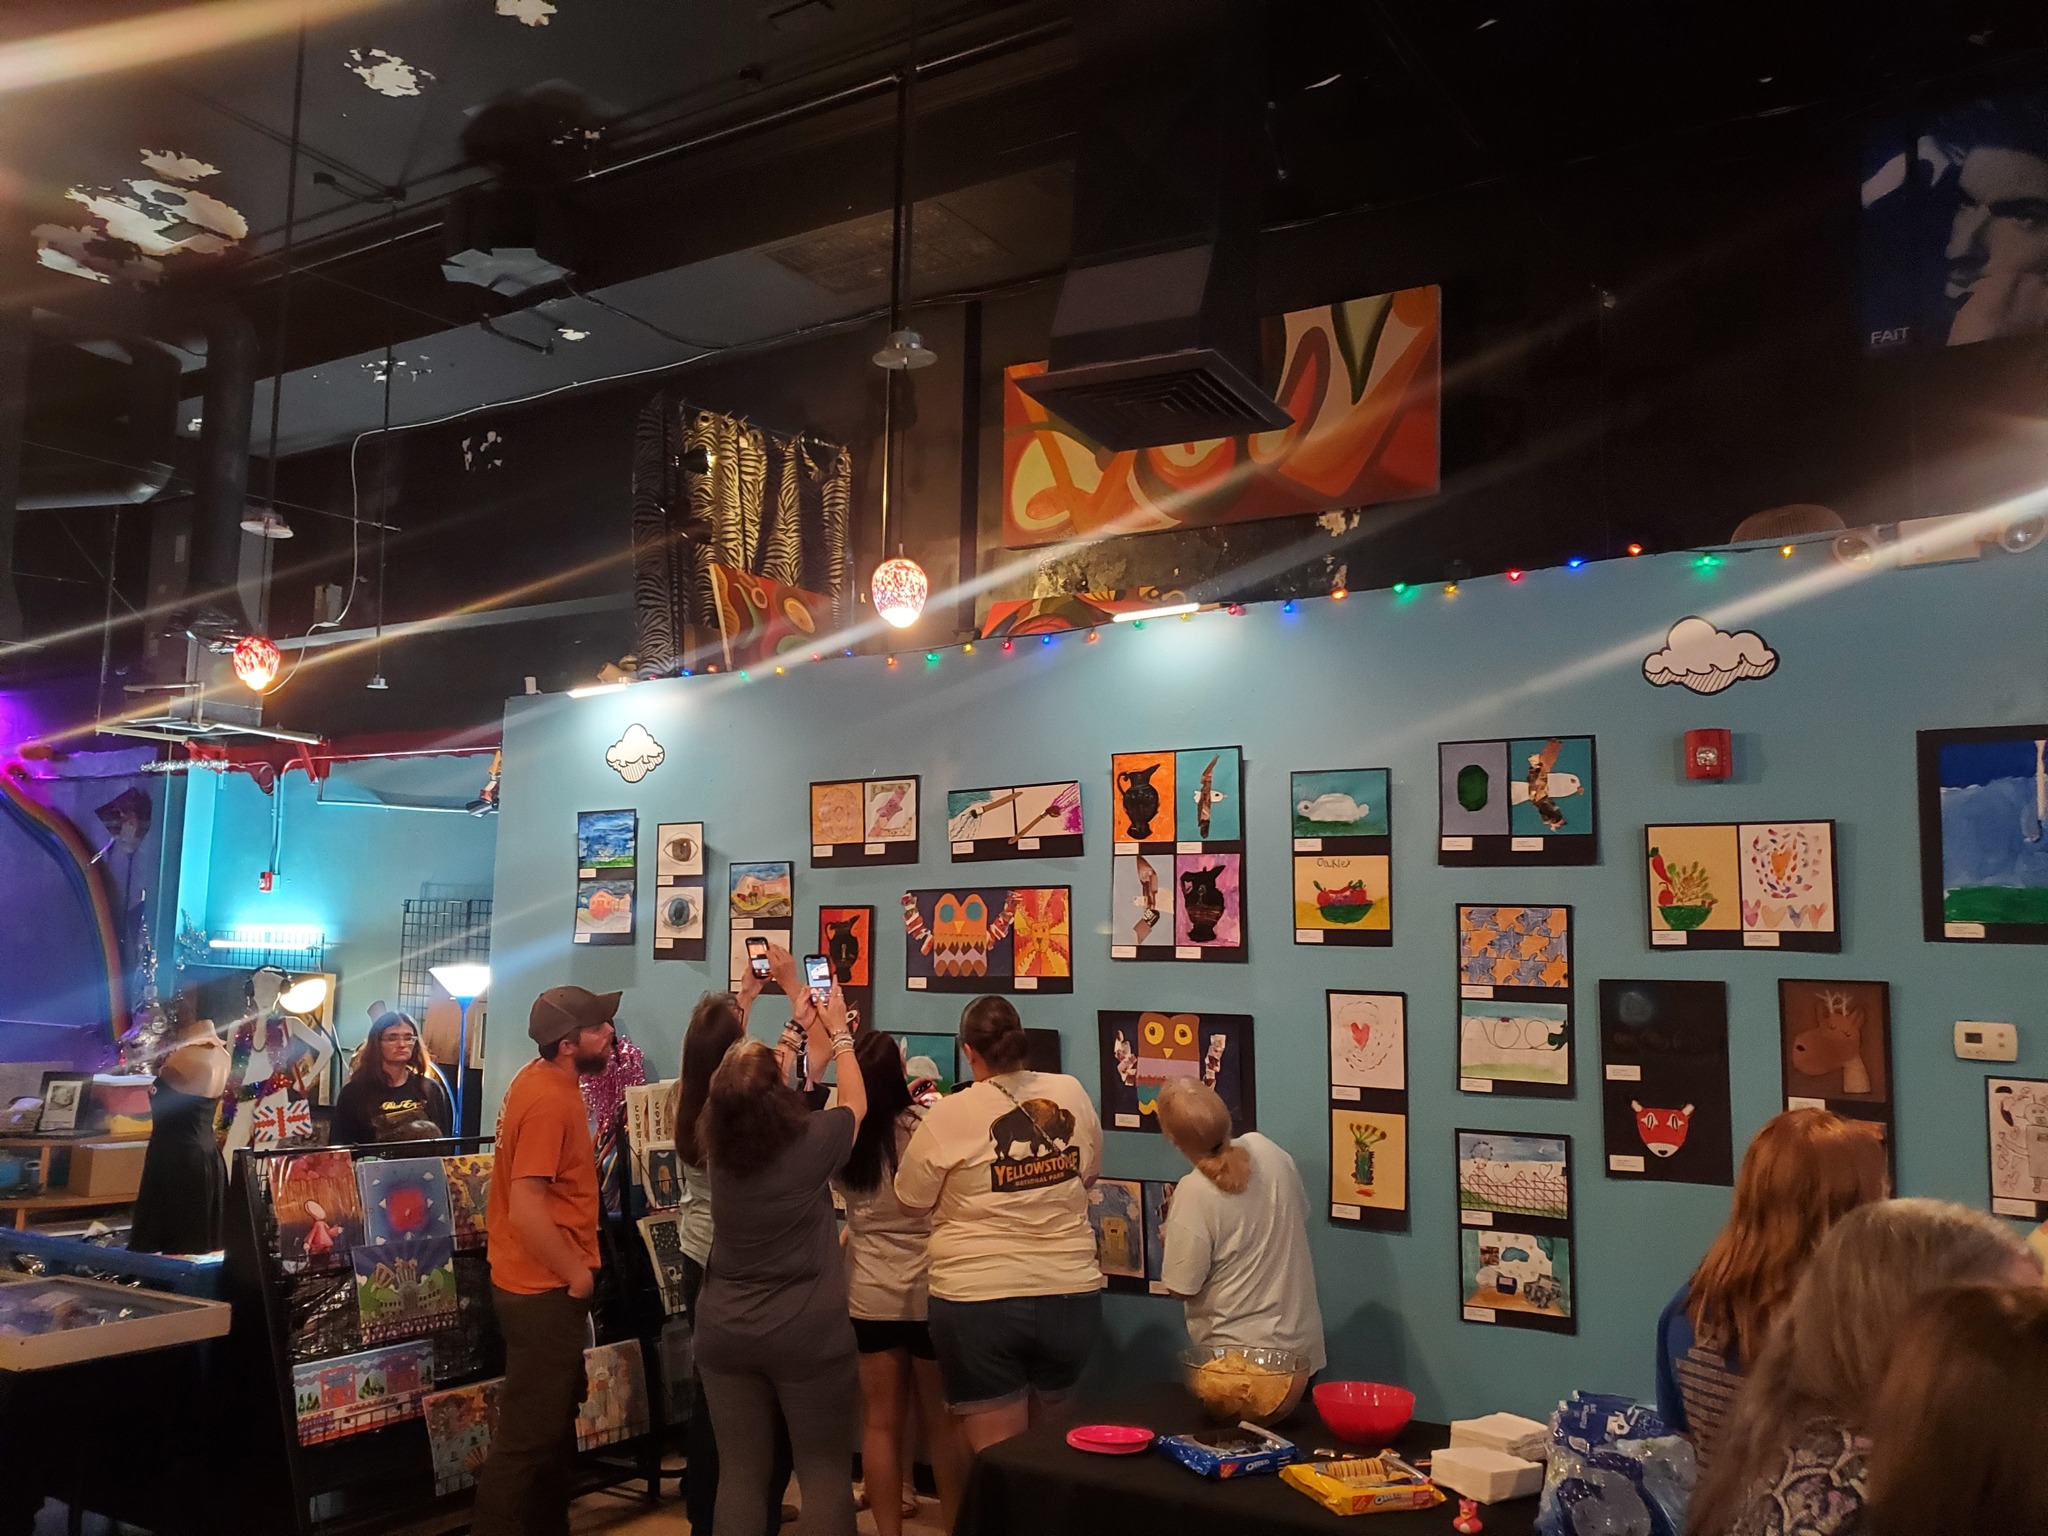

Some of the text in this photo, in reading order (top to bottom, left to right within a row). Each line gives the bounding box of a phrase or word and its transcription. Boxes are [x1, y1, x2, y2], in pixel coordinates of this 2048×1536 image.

[994, 1151, 1078, 1186] YELLOWSTONE
[1014, 1171, 1065, 1187] NATIONAL PARK
